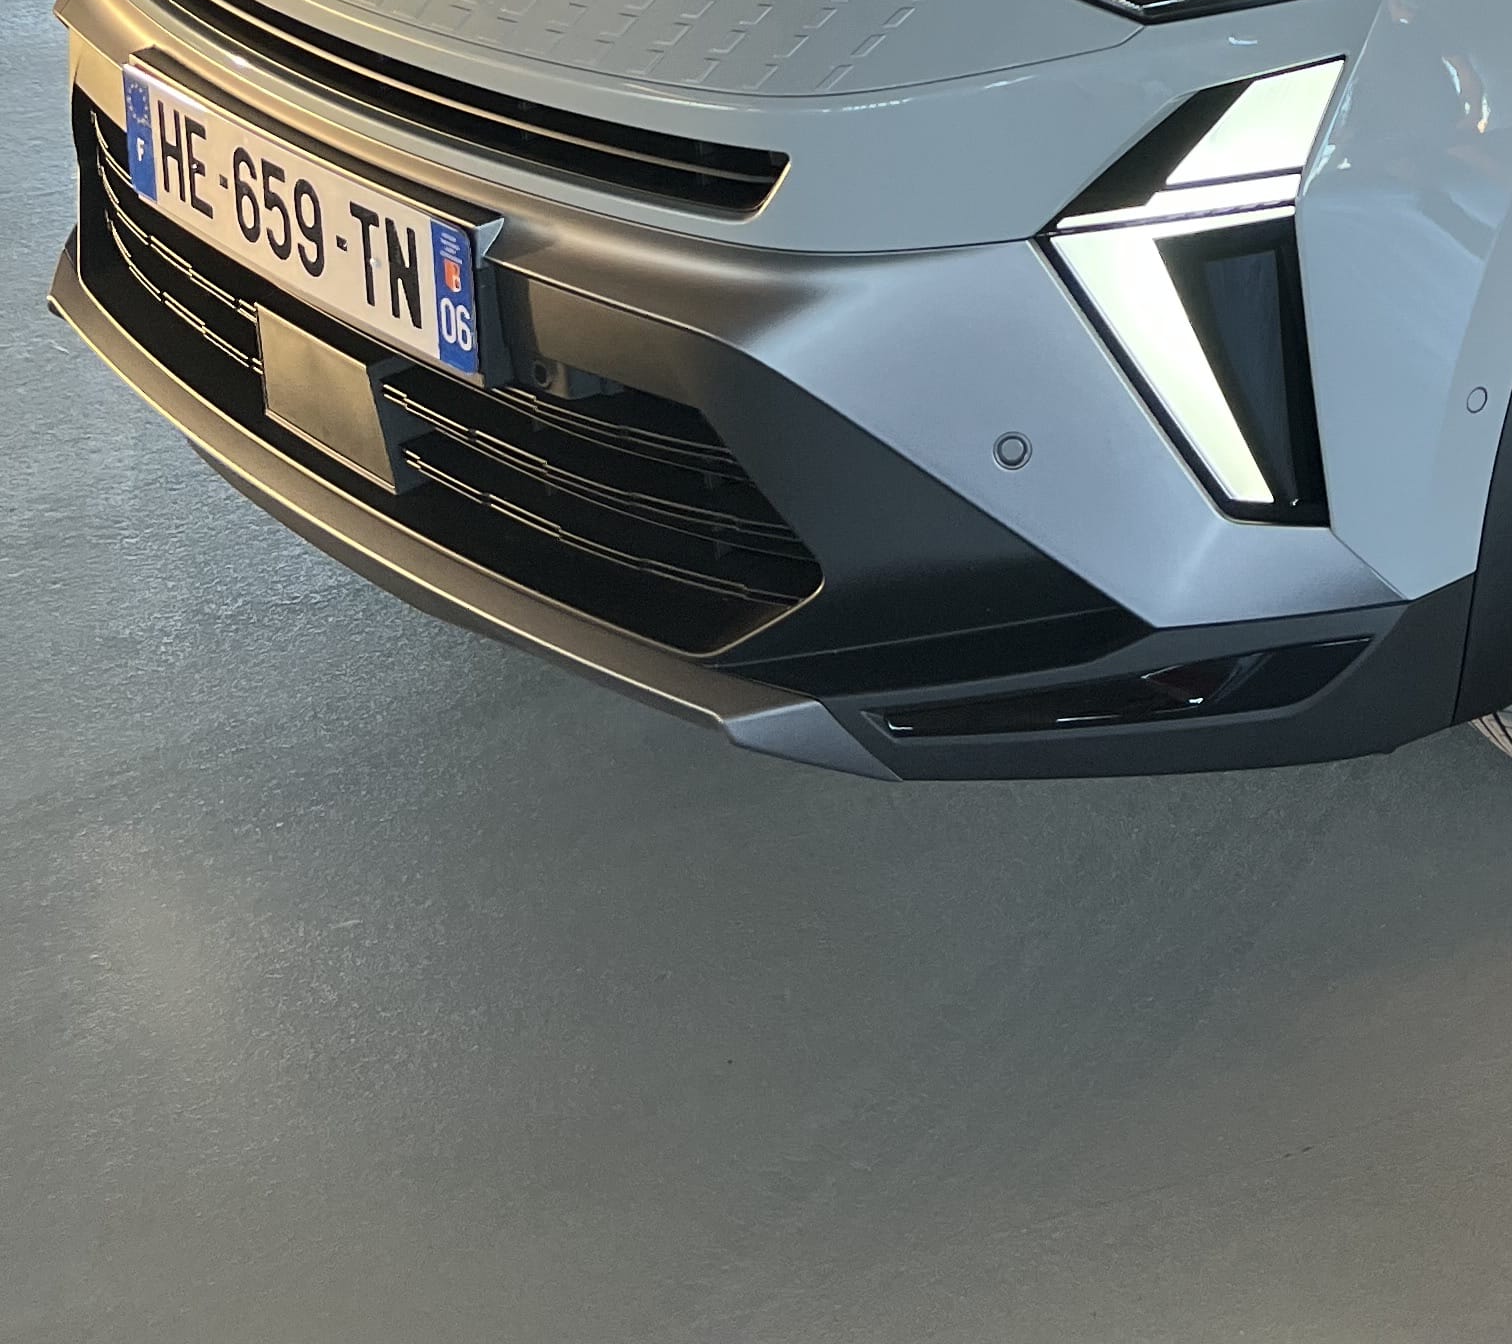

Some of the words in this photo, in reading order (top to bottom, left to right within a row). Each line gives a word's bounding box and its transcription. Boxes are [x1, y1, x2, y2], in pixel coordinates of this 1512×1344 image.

[135, 137, 146, 162] F
[157, 100, 423, 330] HE-659-TN
[439, 297, 473, 352] 06
